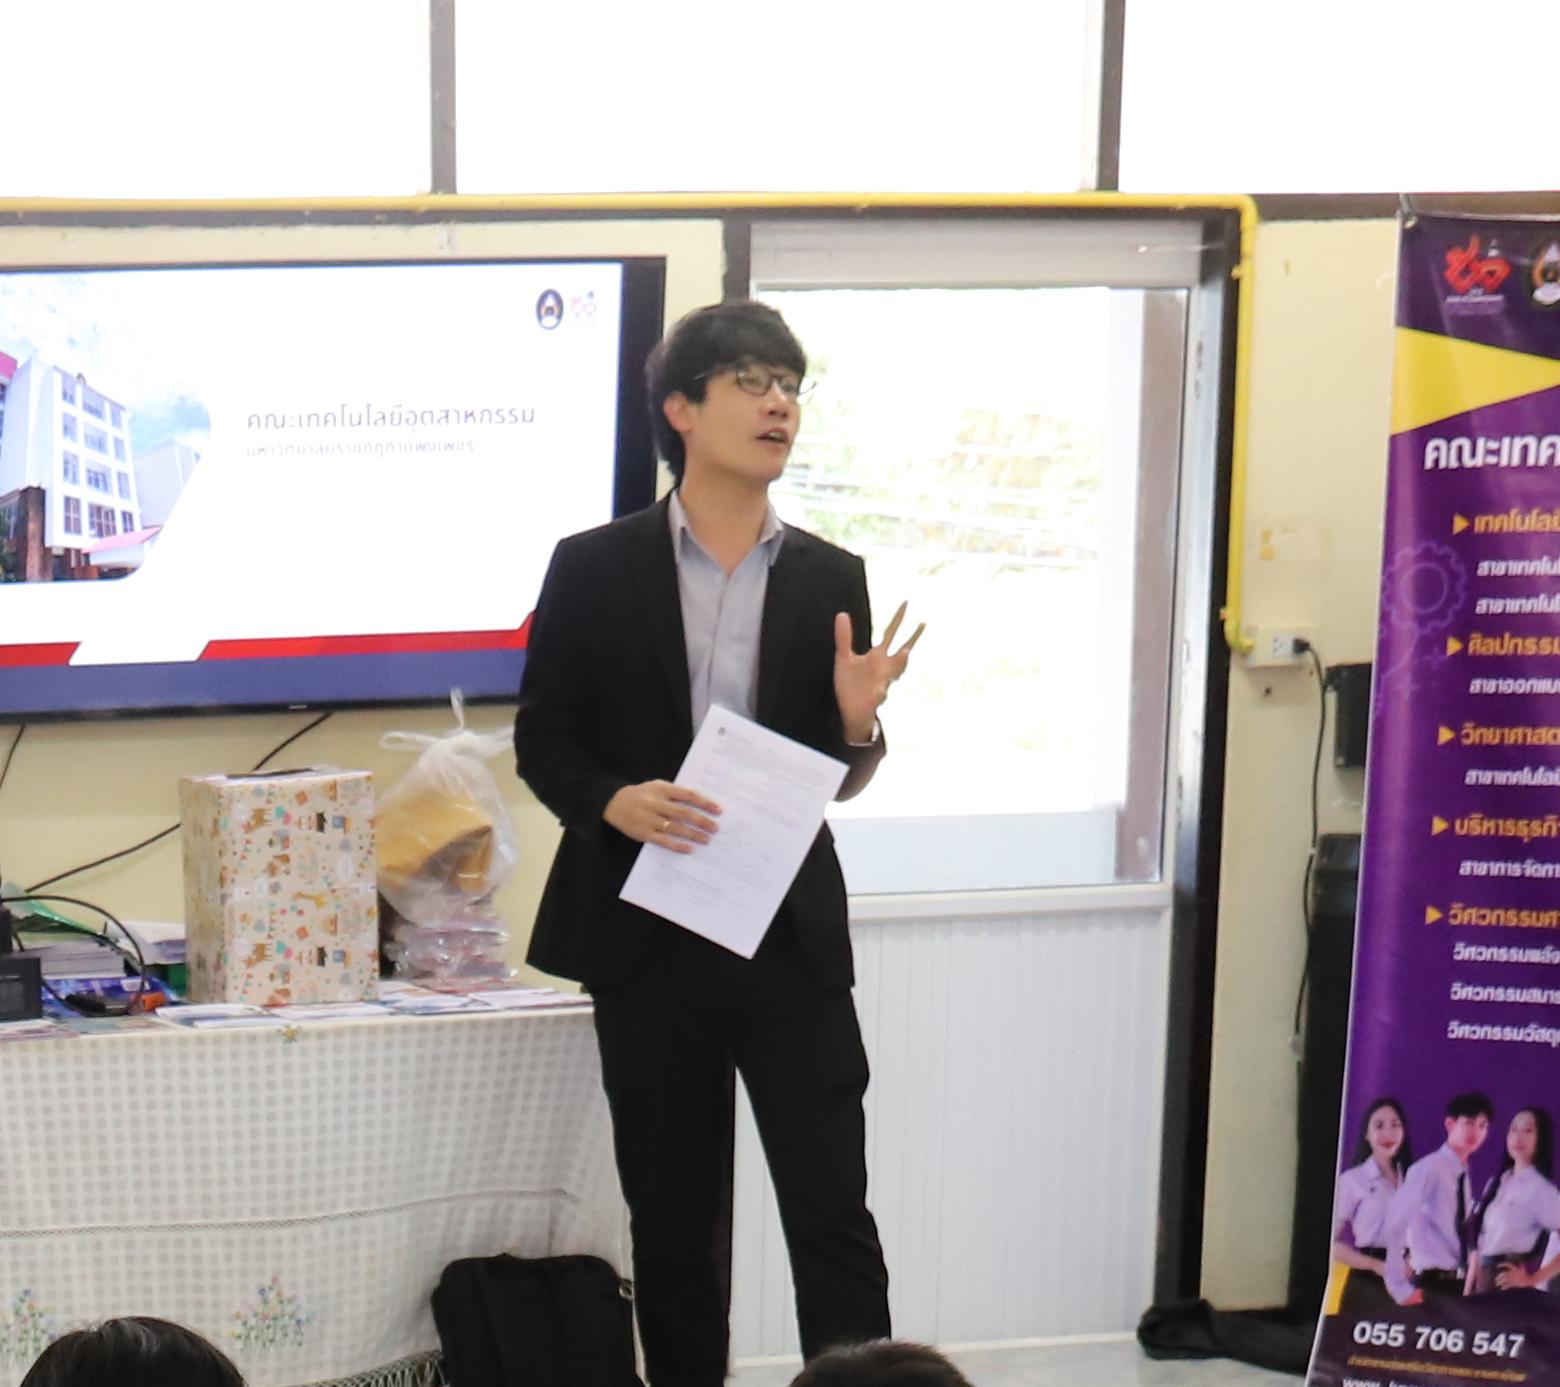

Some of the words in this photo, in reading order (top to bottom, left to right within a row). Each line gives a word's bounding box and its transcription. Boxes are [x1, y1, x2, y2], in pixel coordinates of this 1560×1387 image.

[246, 403, 536, 432] คณะเทคโนโลยีอุตสาหกรรม
[1353, 1319, 1406, 1348] 055
[1415, 1325, 1465, 1353] 706
[1472, 1330, 1525, 1359] 547
